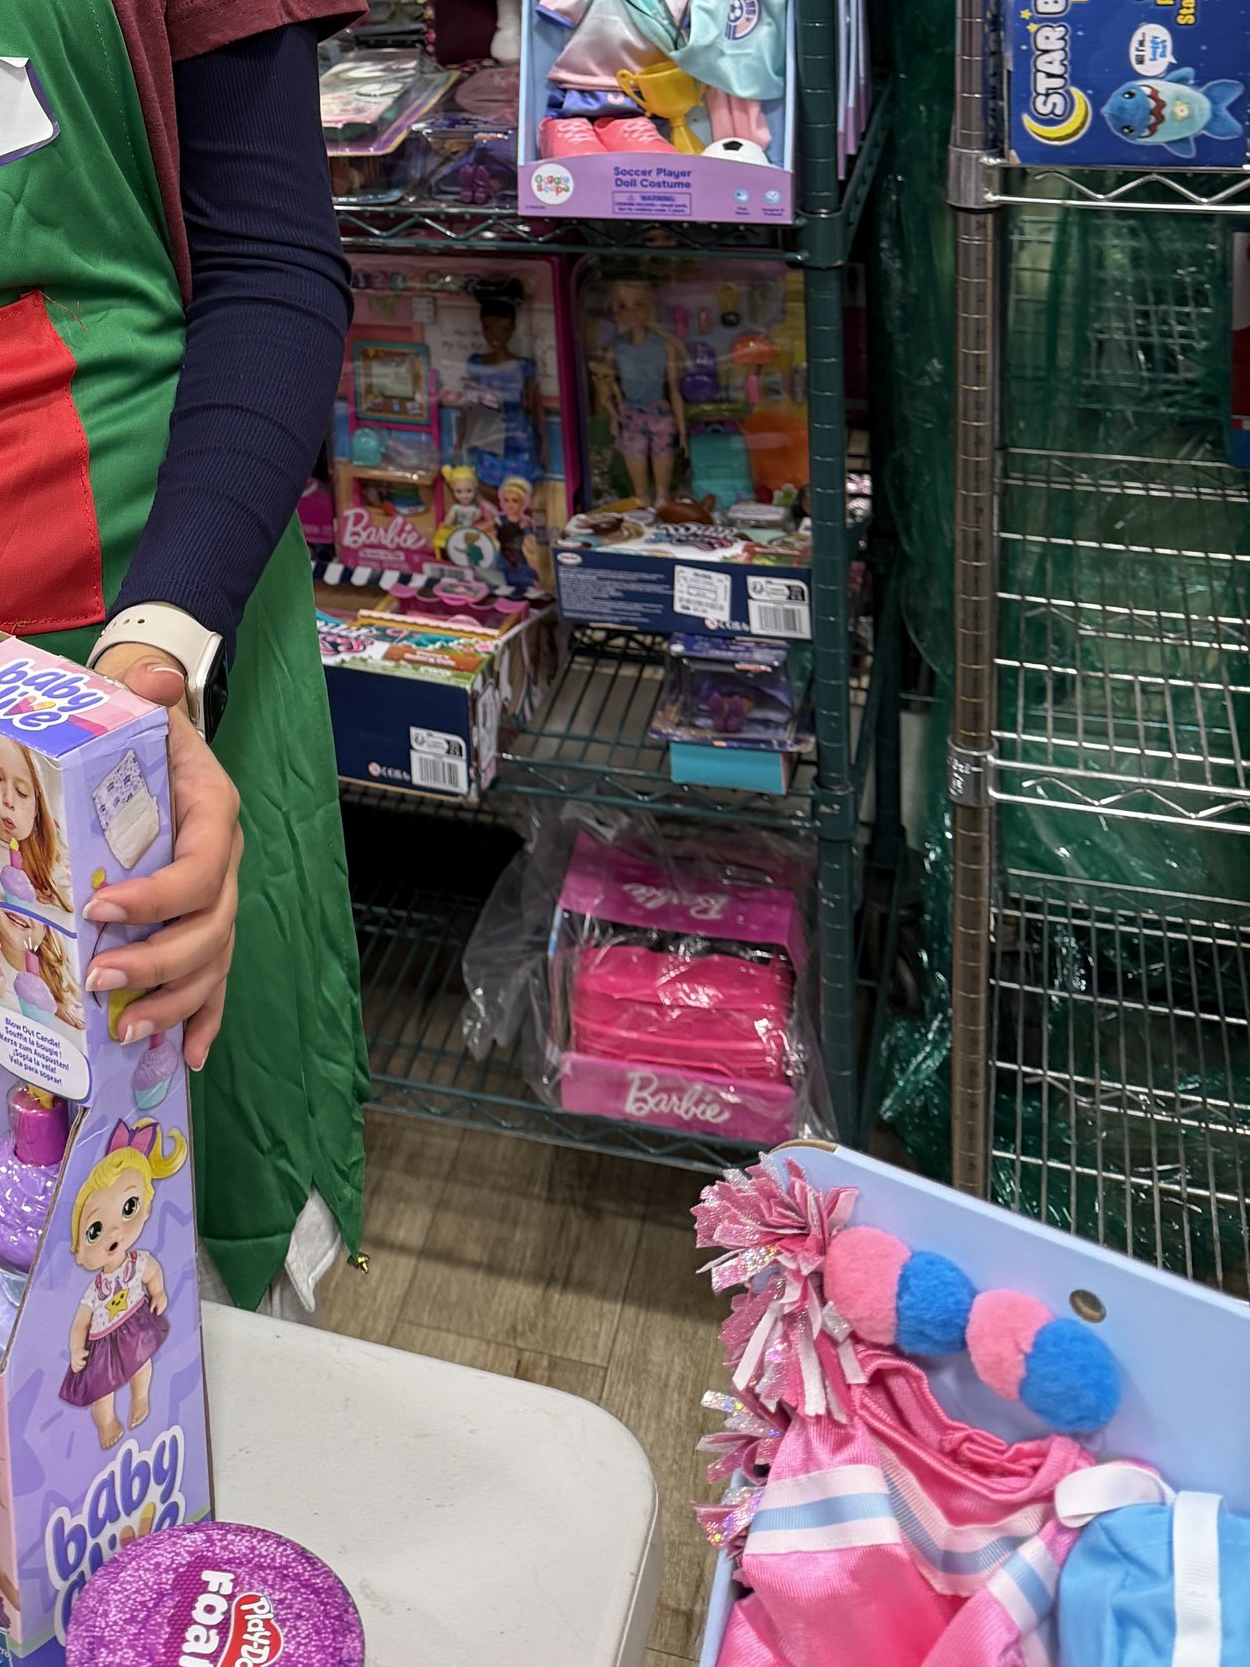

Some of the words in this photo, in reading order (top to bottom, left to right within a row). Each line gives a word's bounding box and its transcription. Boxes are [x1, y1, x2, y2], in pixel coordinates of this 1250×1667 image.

[1033, 25, 1070, 118] STAR
[613, 167, 654, 179] Soccer
[656, 167, 693, 180] Player
[614, 177, 639, 188] Doll
[640, 178, 692, 189] Costume
[342, 506, 428, 551] Barbie
[36, 1032, 61, 1048] Candle!
[8, 1054, 24, 1068] Vela
[626, 1071, 730, 1124] Barbie
[51, 1433, 180, 1583] baby
